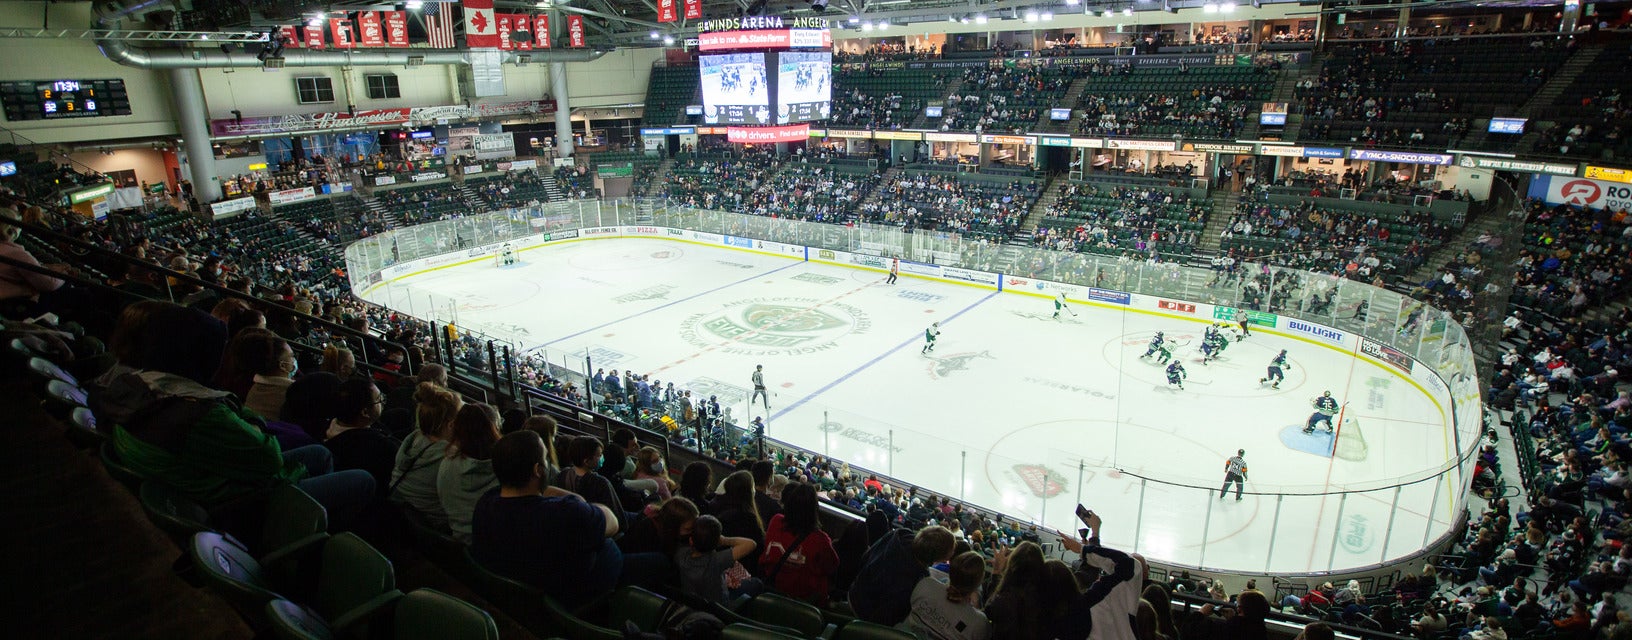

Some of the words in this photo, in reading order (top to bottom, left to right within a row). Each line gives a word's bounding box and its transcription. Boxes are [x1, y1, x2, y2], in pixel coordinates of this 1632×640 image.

[708, 18, 740, 31] WINDS
[741, 17, 784, 29] ARENA
[793, 17, 823, 28] ANGEL
[54, 81, 79, 91] 17:34
[45, 89, 52, 99] 2
[67, 102, 74, 111] 3
[748, 131, 776, 139] drivers.
[1606, 186, 1632, 199] RO
[1289, 321, 1312, 332] BUD
[1312, 326, 1343, 341] LIGHT
[1322, 402, 1333, 411] 35
